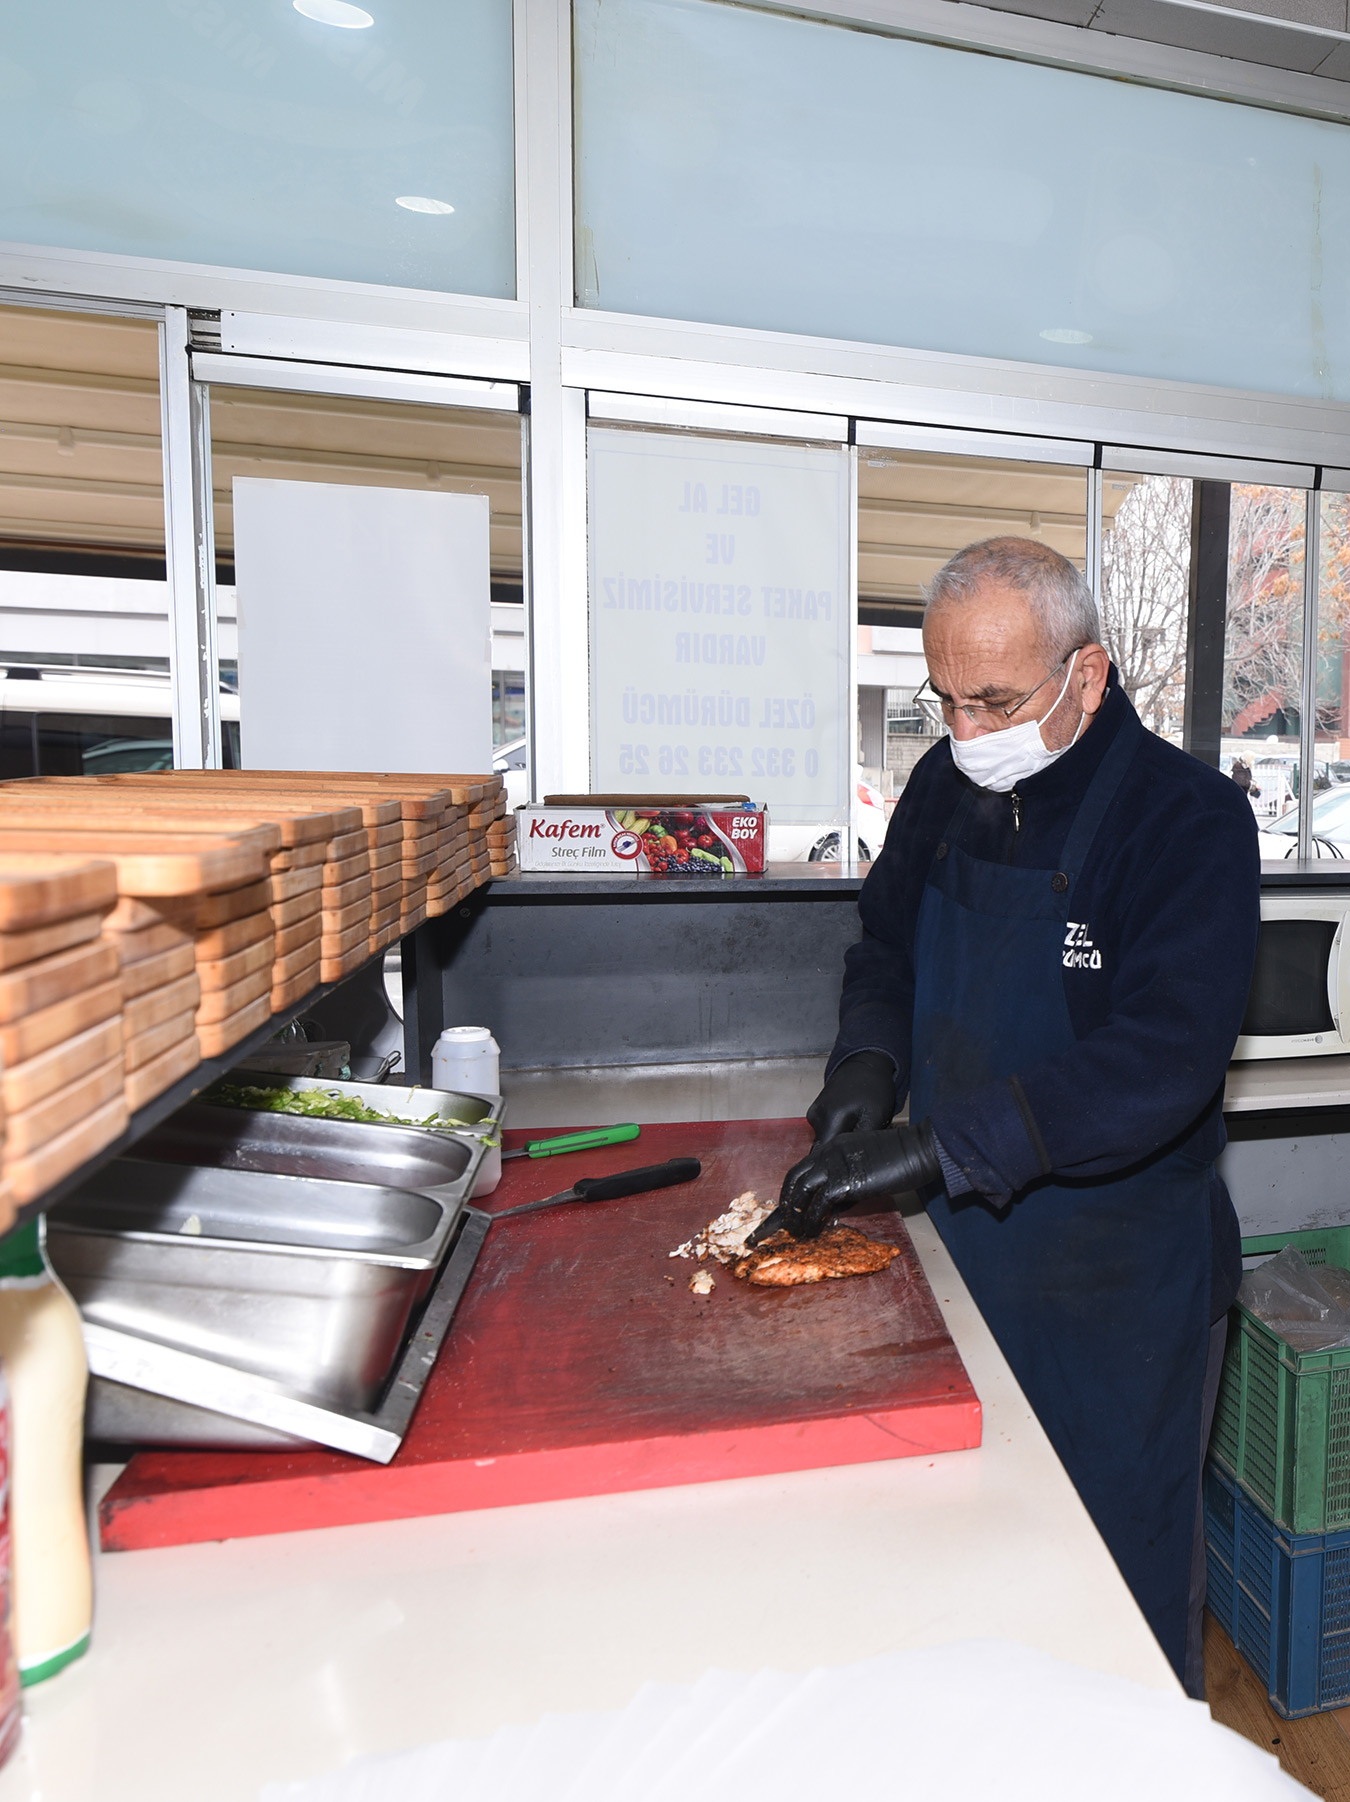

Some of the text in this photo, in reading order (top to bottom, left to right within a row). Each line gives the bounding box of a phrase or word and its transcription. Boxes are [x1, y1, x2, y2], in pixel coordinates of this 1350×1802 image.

[732, 816, 758, 828] EKO
[529, 819, 601, 841] Kafem
[731, 828, 758, 840] BOY
[551, 847, 606, 860] Streç Film
[1064, 921, 1094, 948] ZEL
